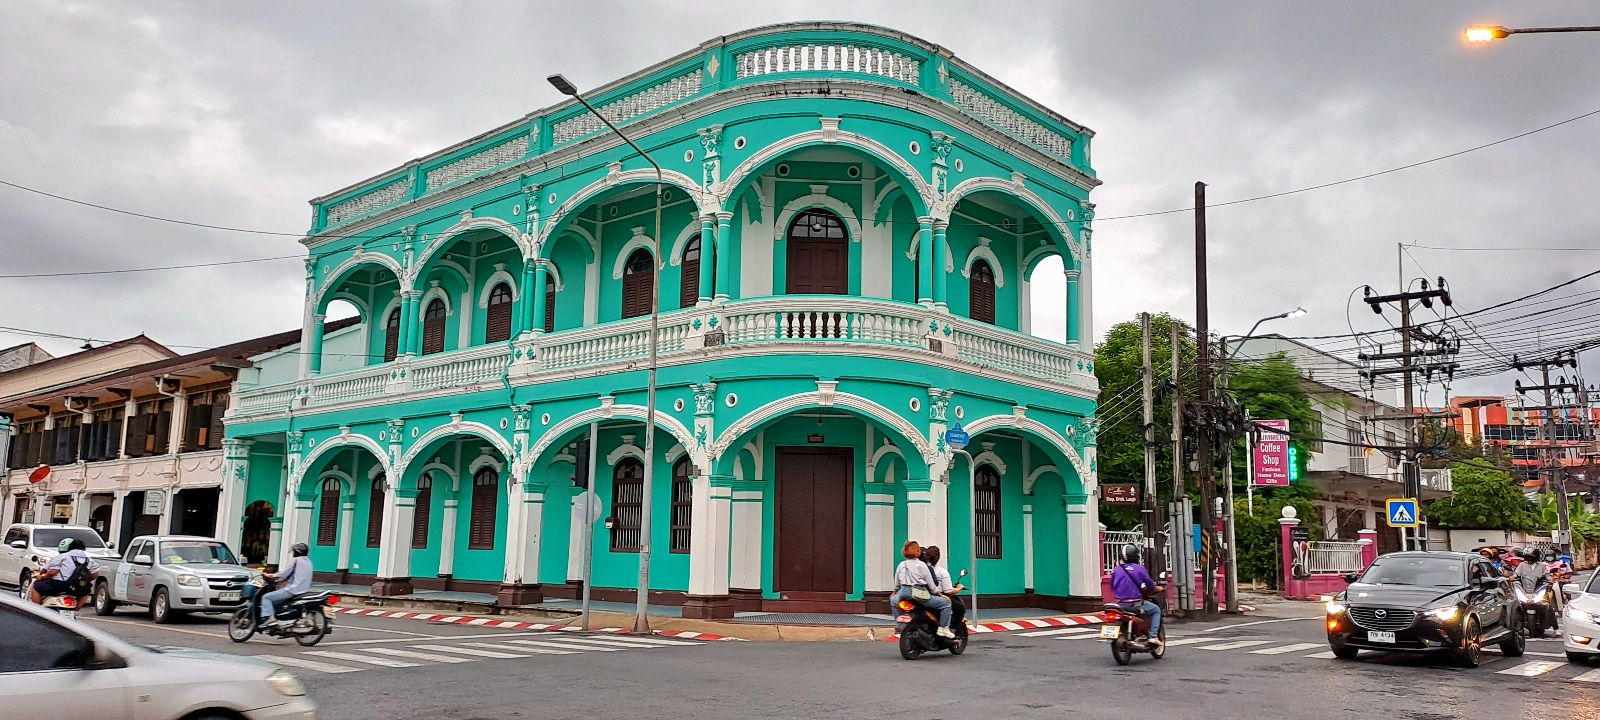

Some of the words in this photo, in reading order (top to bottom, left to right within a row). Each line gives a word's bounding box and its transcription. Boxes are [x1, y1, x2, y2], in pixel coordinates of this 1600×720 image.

[1260, 443, 1281, 452] Coffee
[1262, 455, 1279, 466] Shop
[1288, 448, 1298, 480] OPEN
